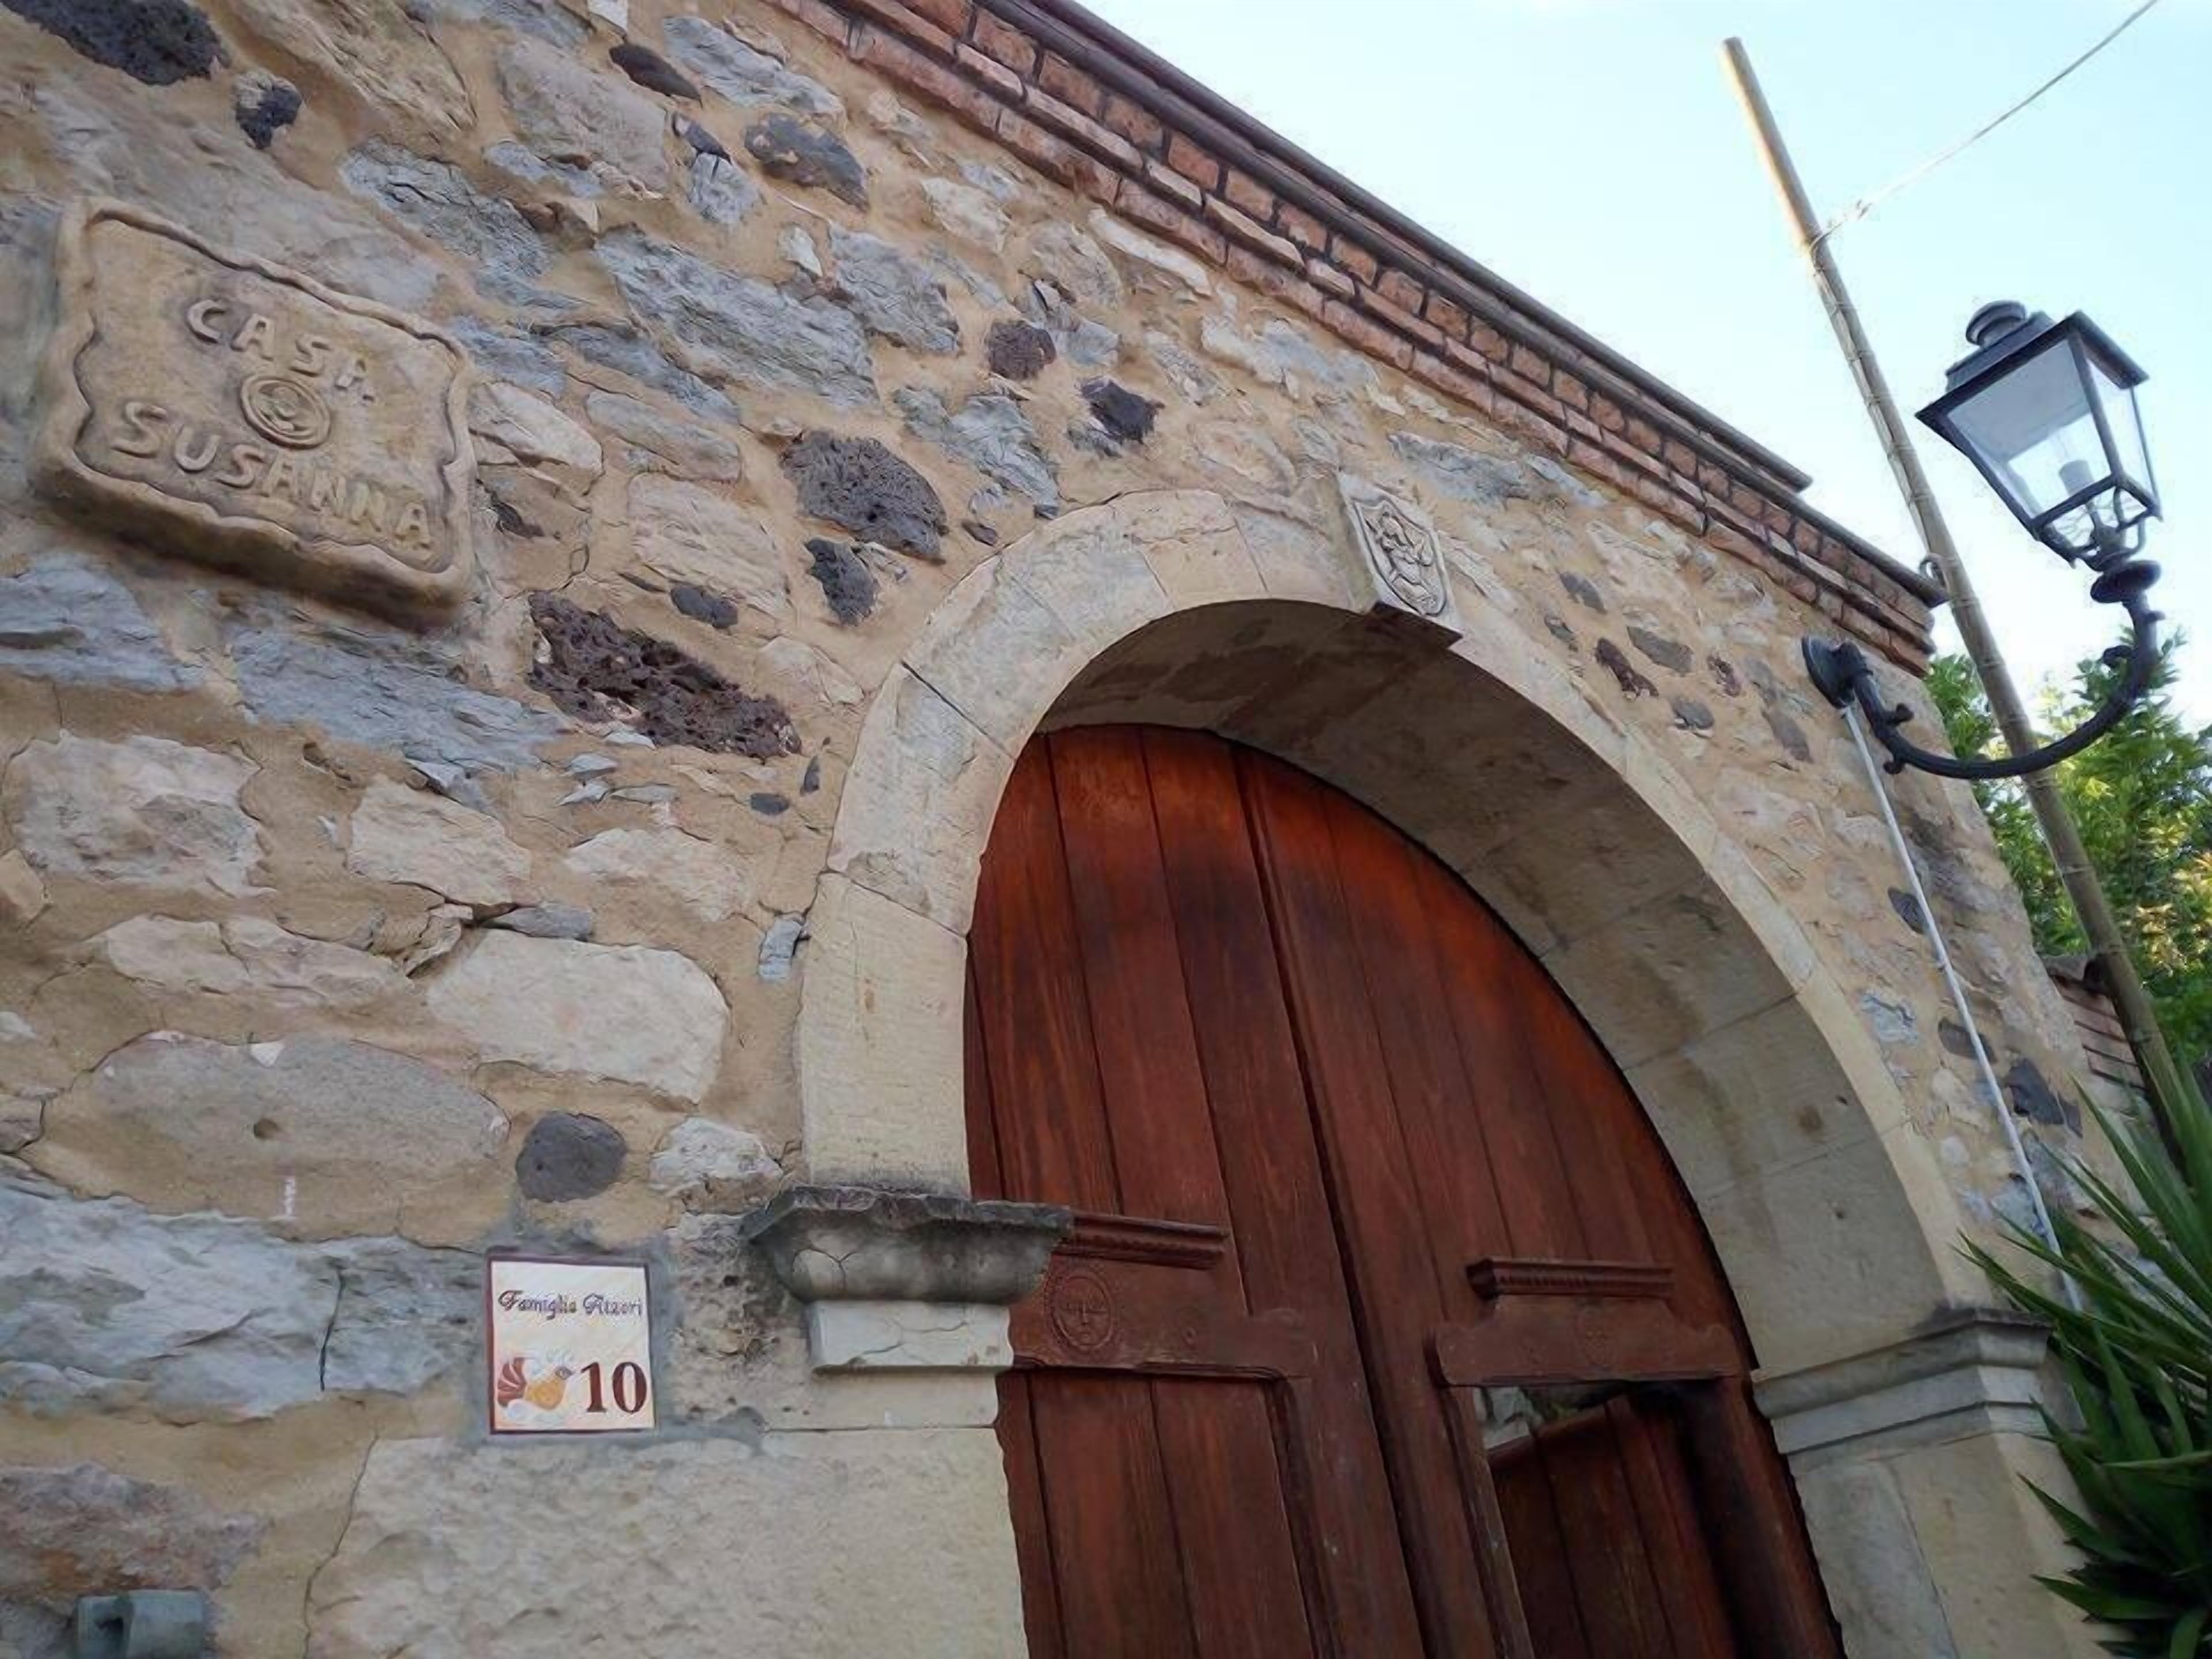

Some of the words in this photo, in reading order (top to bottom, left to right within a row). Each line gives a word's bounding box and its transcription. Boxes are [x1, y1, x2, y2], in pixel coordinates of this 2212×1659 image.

[187, 299, 375, 402] CASA
[111, 402, 432, 549] SUSANNA
[498, 1290, 577, 1320] Famiglia
[581, 1362, 647, 1414] 10
